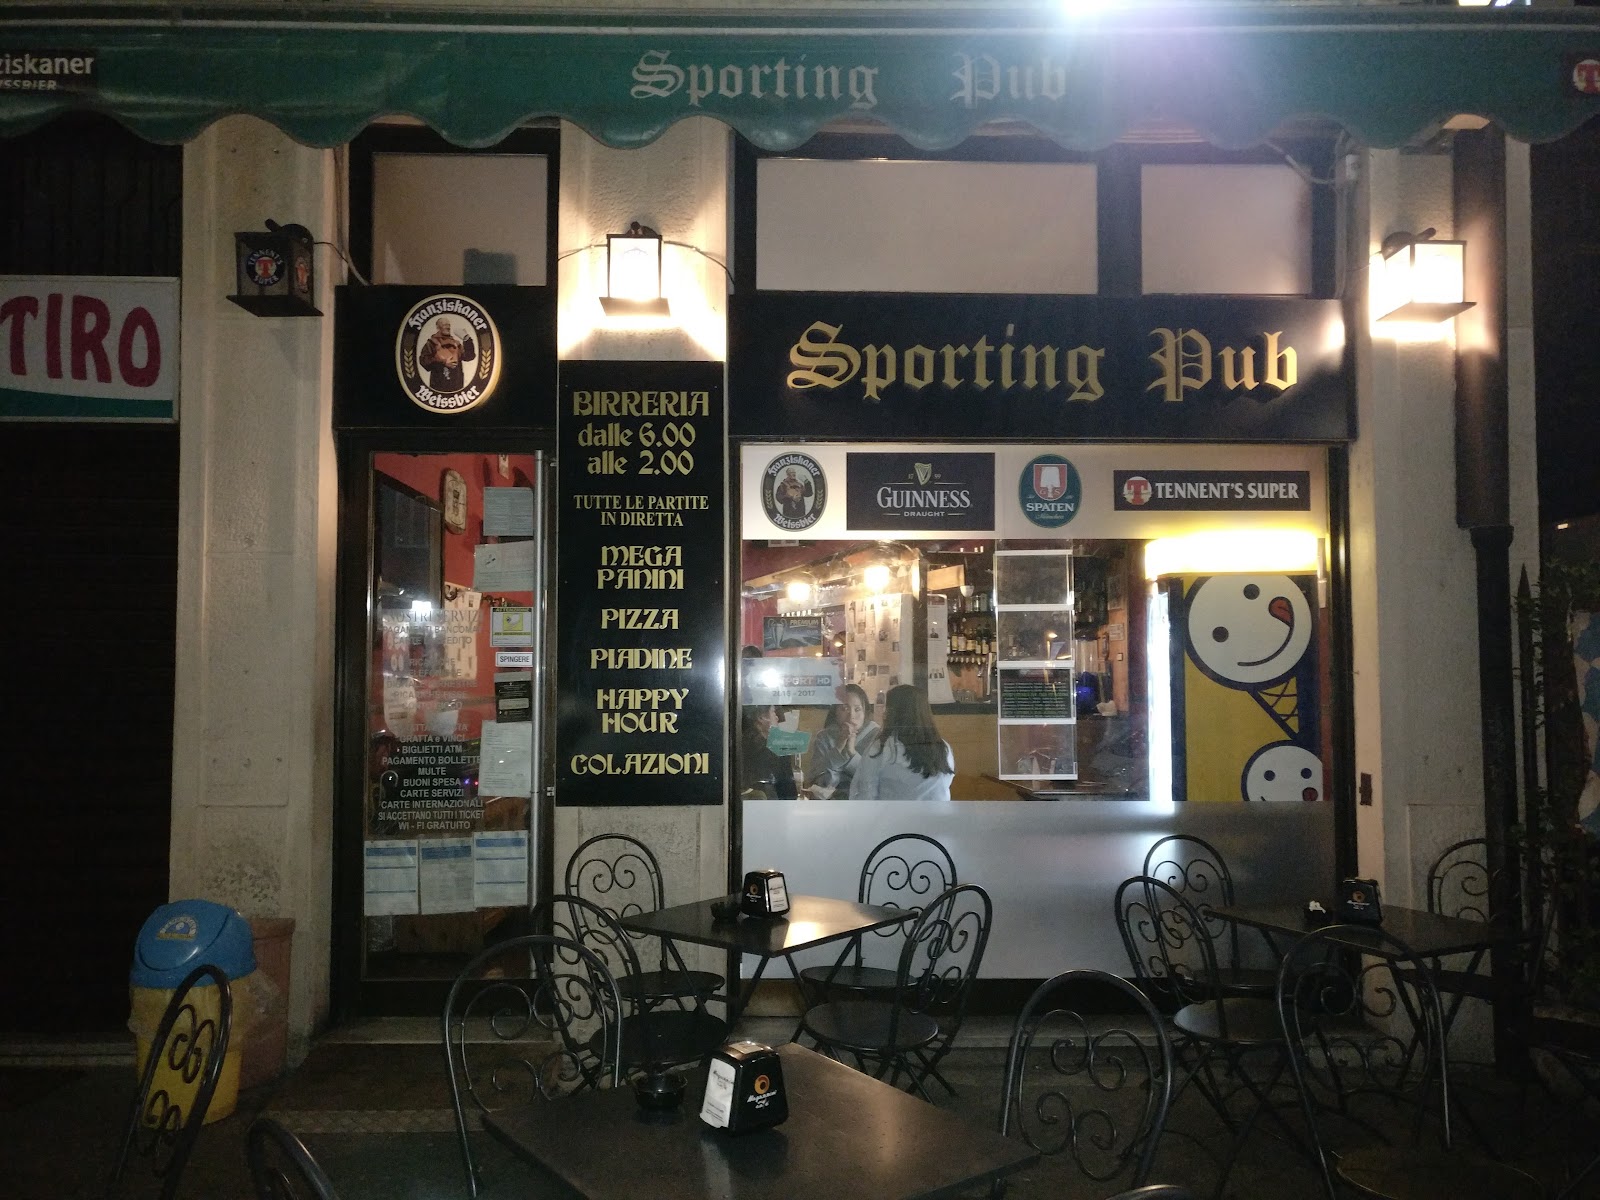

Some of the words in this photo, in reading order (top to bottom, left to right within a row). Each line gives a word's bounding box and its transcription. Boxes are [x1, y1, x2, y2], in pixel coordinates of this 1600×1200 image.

[630, 48, 879, 110] Sporting
[948, 50, 1067, 109] Pub
[408, 299, 487, 331] Franziskaner
[0, 293, 161, 388] TIRO
[787, 321, 1105, 402] Sporting
[1146, 327, 1299, 402] Pub
[415, 385, 480, 409] Weissbier
[573, 390, 709, 417] BIRRERIA
[578, 422, 633, 447] dalle
[639, 422, 696, 447] 6.00
[587, 450, 628, 475] alle
[638, 450, 694, 475] 2.00
[768, 455, 820, 477] Franziskaner
[876, 486, 971, 509] GUINNESS
[1155, 482, 1245, 499] TENNENT'S
[1247, 482, 1299, 499] SUPER
[573, 495, 621, 509] TUTTE
[626, 495, 644, 510] LE
[648, 495, 709, 510] PARTITE
[1026, 502, 1075, 512] SPATEN
[601, 512, 616, 526] IN
[620, 512, 683, 527] DIRETTA
[773, 512, 817, 530] Weissbier
[601, 545, 682, 567] MEGA
[597, 569, 684, 590] PANINI
[601, 609, 679, 630] PIZZA
[500, 655, 530, 663] SPINGERE
[591, 648, 692, 669] PIADINE
[817, 677, 830, 685] HD
[597, 688, 690, 710] HAPPY
[602, 712, 679, 734] HOUR
[399, 734, 433, 743] GRATTA
[443, 734, 465, 743] VINCI
[402, 745, 443, 754] BIGLIETTI
[444, 745, 463, 754] ATM
[382, 756, 436, 766] PAGAMENTO
[418, 767, 446, 776] MULTE
[571, 753, 709, 775] COLAZIONI
[403, 779, 430, 787] BUONI
[433, 778, 461, 787] SPESA
[400, 790, 429, 798] CARTE
[432, 789, 464, 798] SERVIZI
[381, 801, 410, 809] CARTE
[412, 800, 484, 809] INTERNAZIONALI
[379, 812, 387, 821] SI
[388, 811, 431, 821] ACCETTANO
[433, 811, 455, 819] TUTTI
[460, 811, 485, 819] TICKET
[398, 822, 410, 831] WI
[417, 822, 425, 830] FI
[427, 821, 470, 830] GRATUITO
